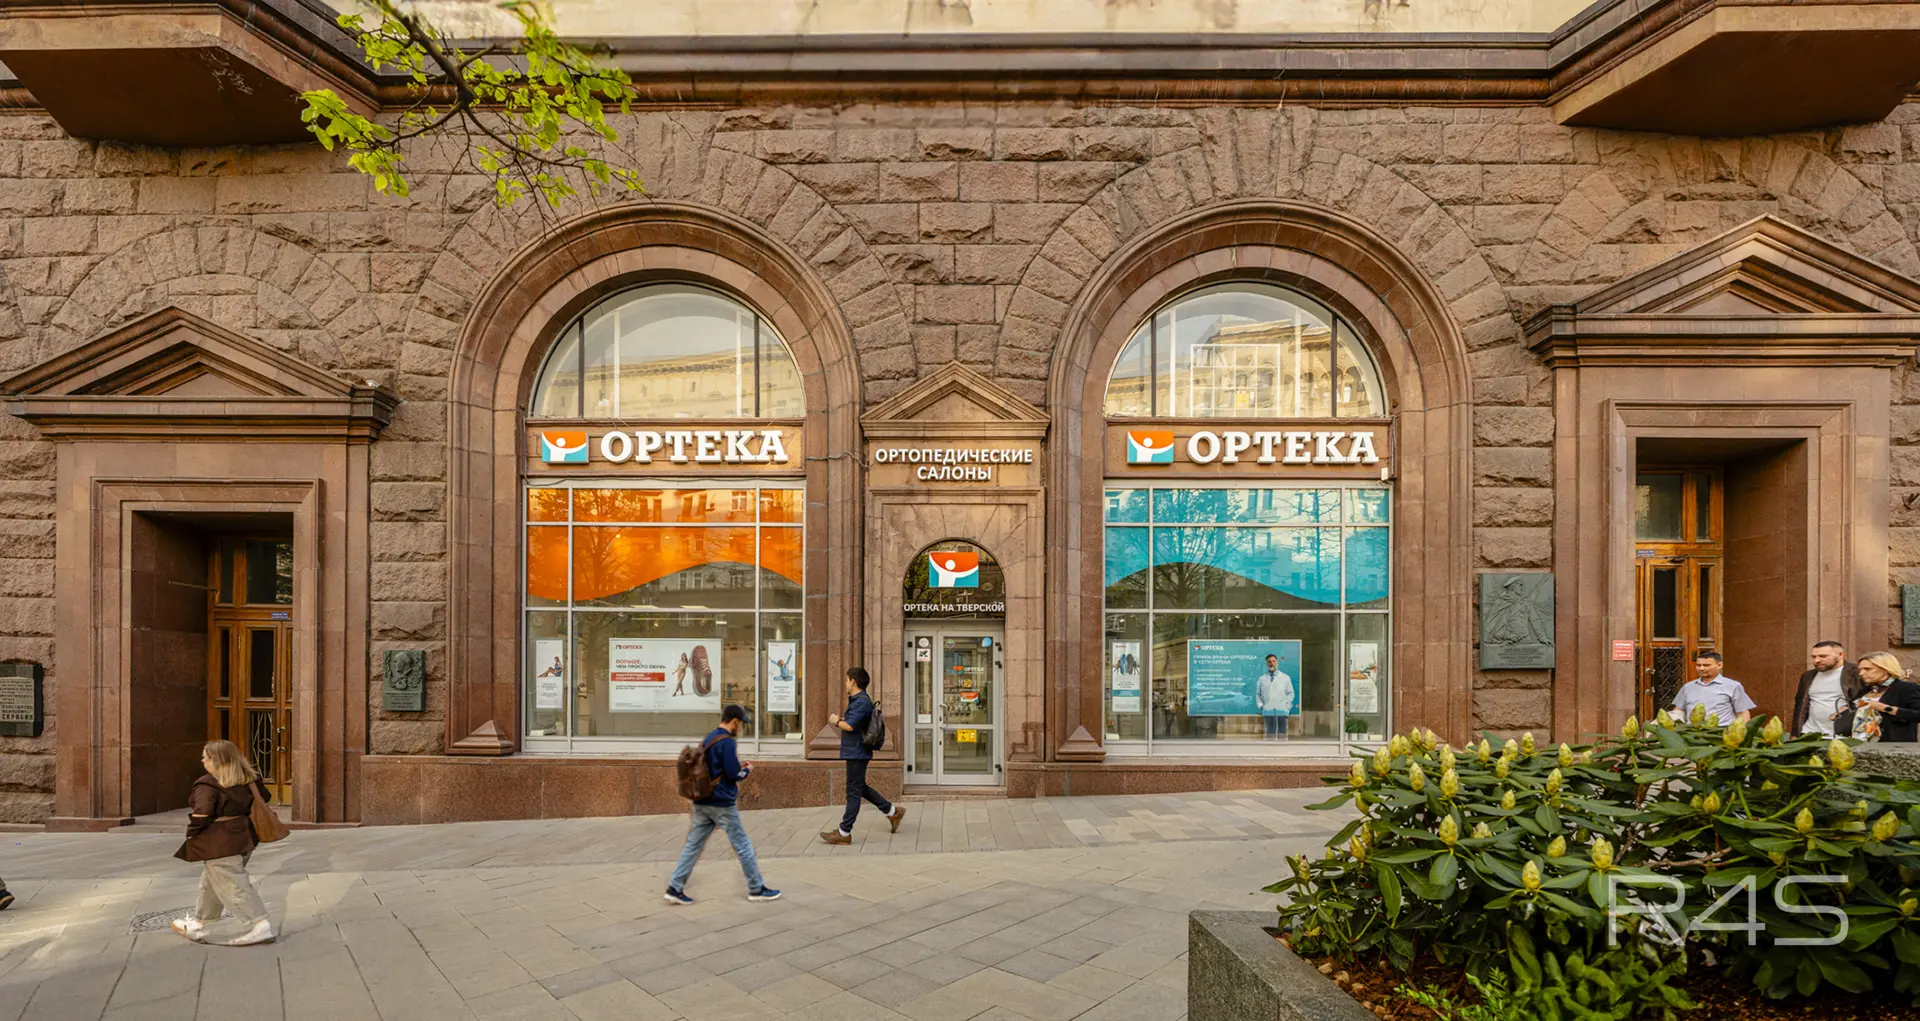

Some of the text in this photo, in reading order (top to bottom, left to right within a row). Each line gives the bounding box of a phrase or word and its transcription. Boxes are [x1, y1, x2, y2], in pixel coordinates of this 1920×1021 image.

[600, 430, 789, 464] ОРТЕКА
[1187, 430, 1380, 465] ОРТЕКА
[875, 448, 1033, 465] ОРТОПЕДИЧЕСКИЕ
[916, 466, 992, 481] САЛОНЫ
[903, 602, 1005, 612] ОРТЕКА НА ТВЕРСКОЙ
